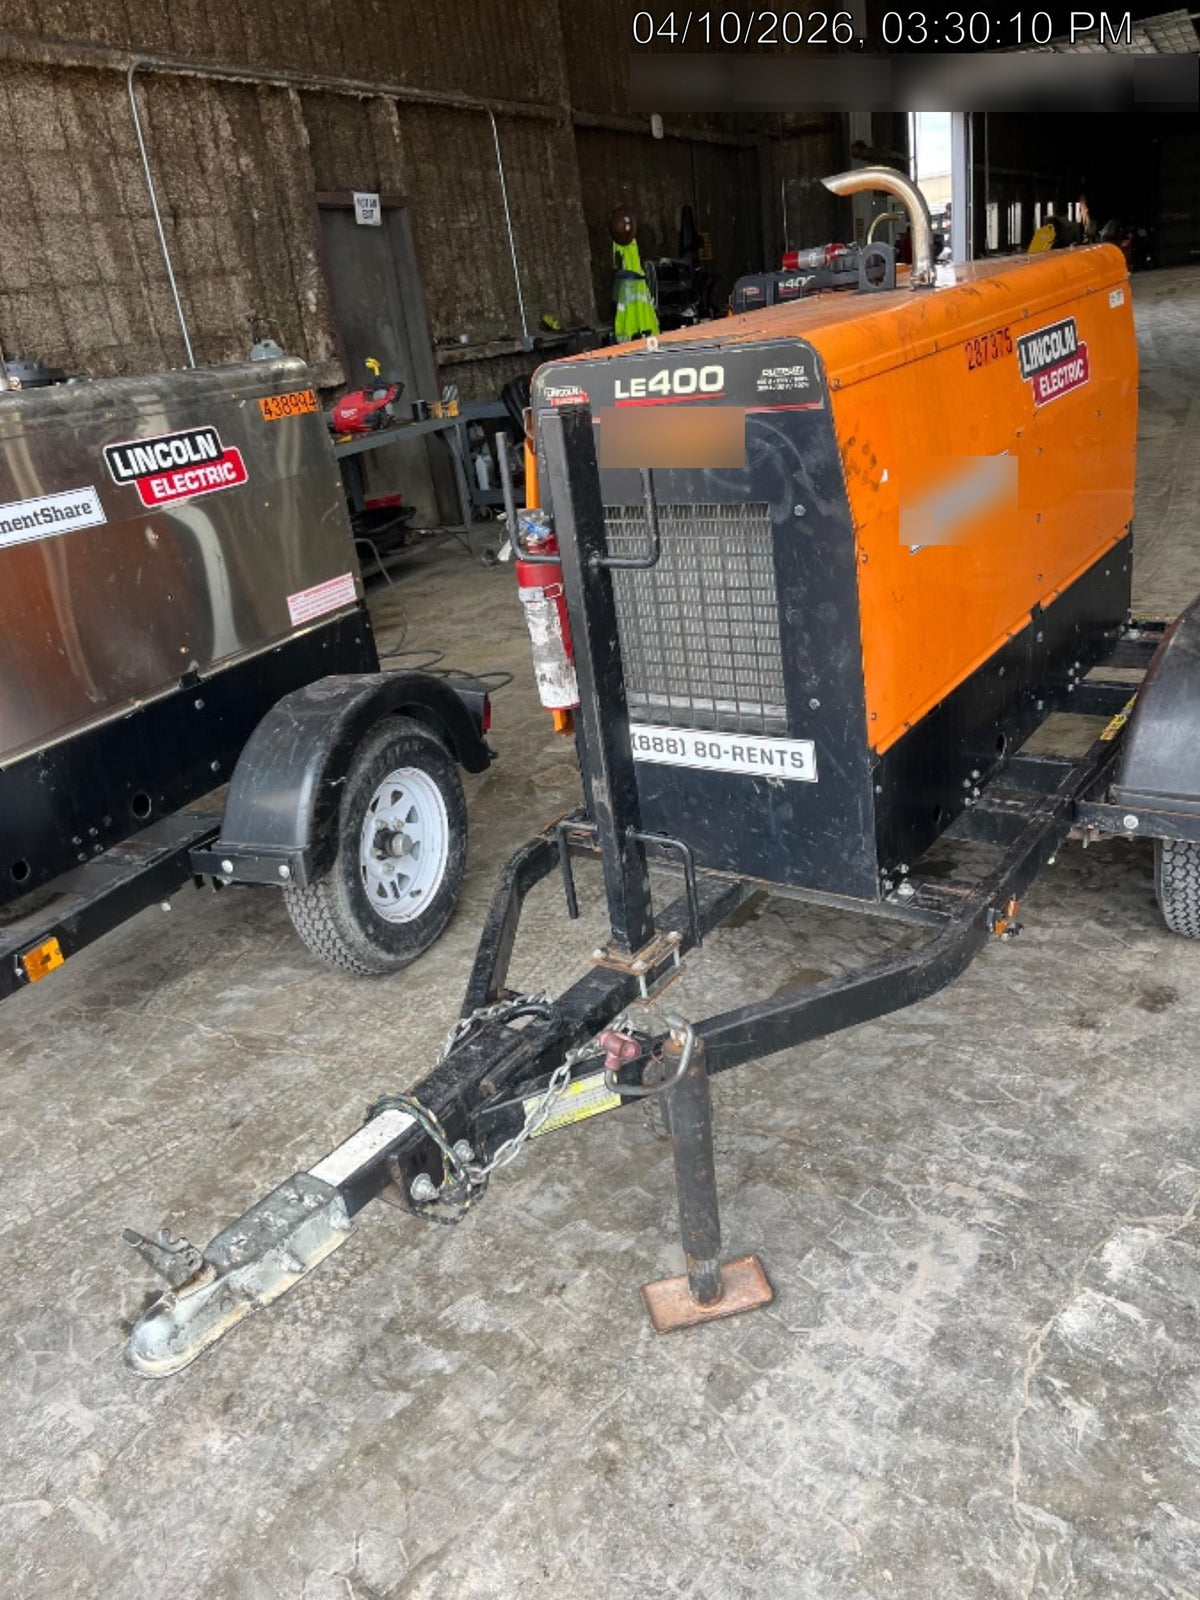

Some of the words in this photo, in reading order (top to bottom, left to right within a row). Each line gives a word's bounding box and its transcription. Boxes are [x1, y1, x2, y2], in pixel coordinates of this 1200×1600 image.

[964, 326, 1013, 371] 287375
[1020, 324, 1077, 373] LINCOLN
[614, 365, 725, 399] LE400
[1039, 358, 1085, 398] ELECTRIC
[112, 433, 218, 478] LINCOLN
[150, 461, 237, 499] ELECTRIC
[631, 732, 686, 757] (888)
[694, 741, 804, 769] 80-RENTS
